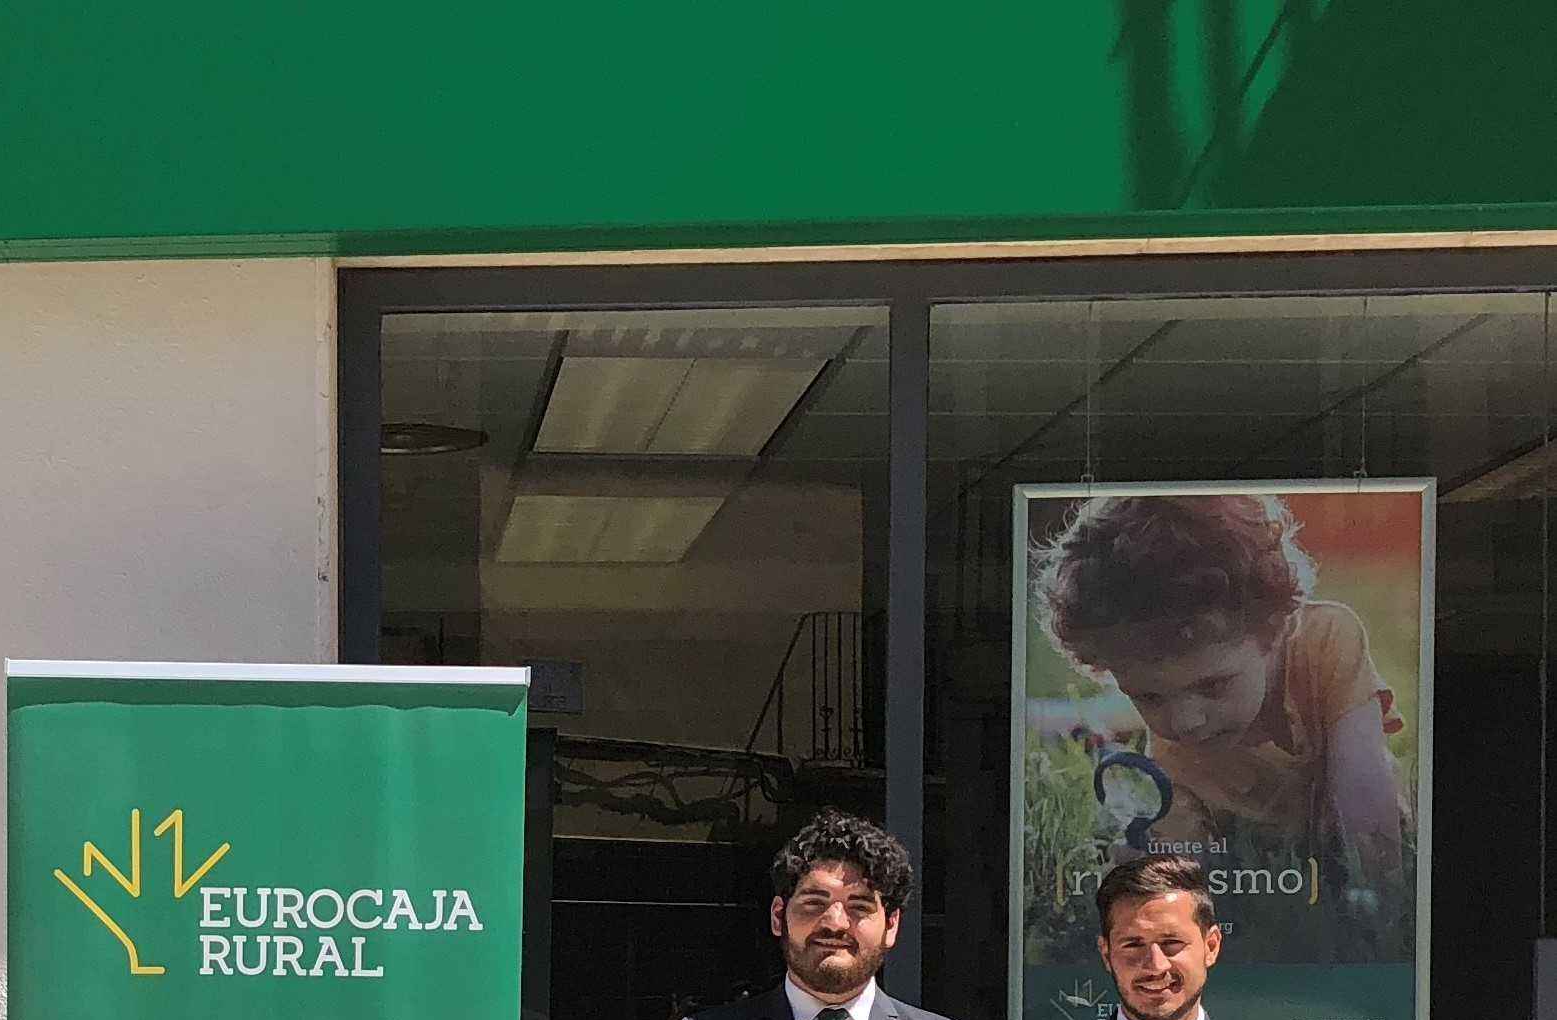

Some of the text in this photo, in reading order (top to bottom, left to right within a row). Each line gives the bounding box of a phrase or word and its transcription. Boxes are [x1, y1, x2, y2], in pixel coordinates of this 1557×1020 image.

[1148, 837, 1228, 855] únete al
[199, 887, 483, 931] EUROCAJA
[199, 935, 384, 978] RURAL
